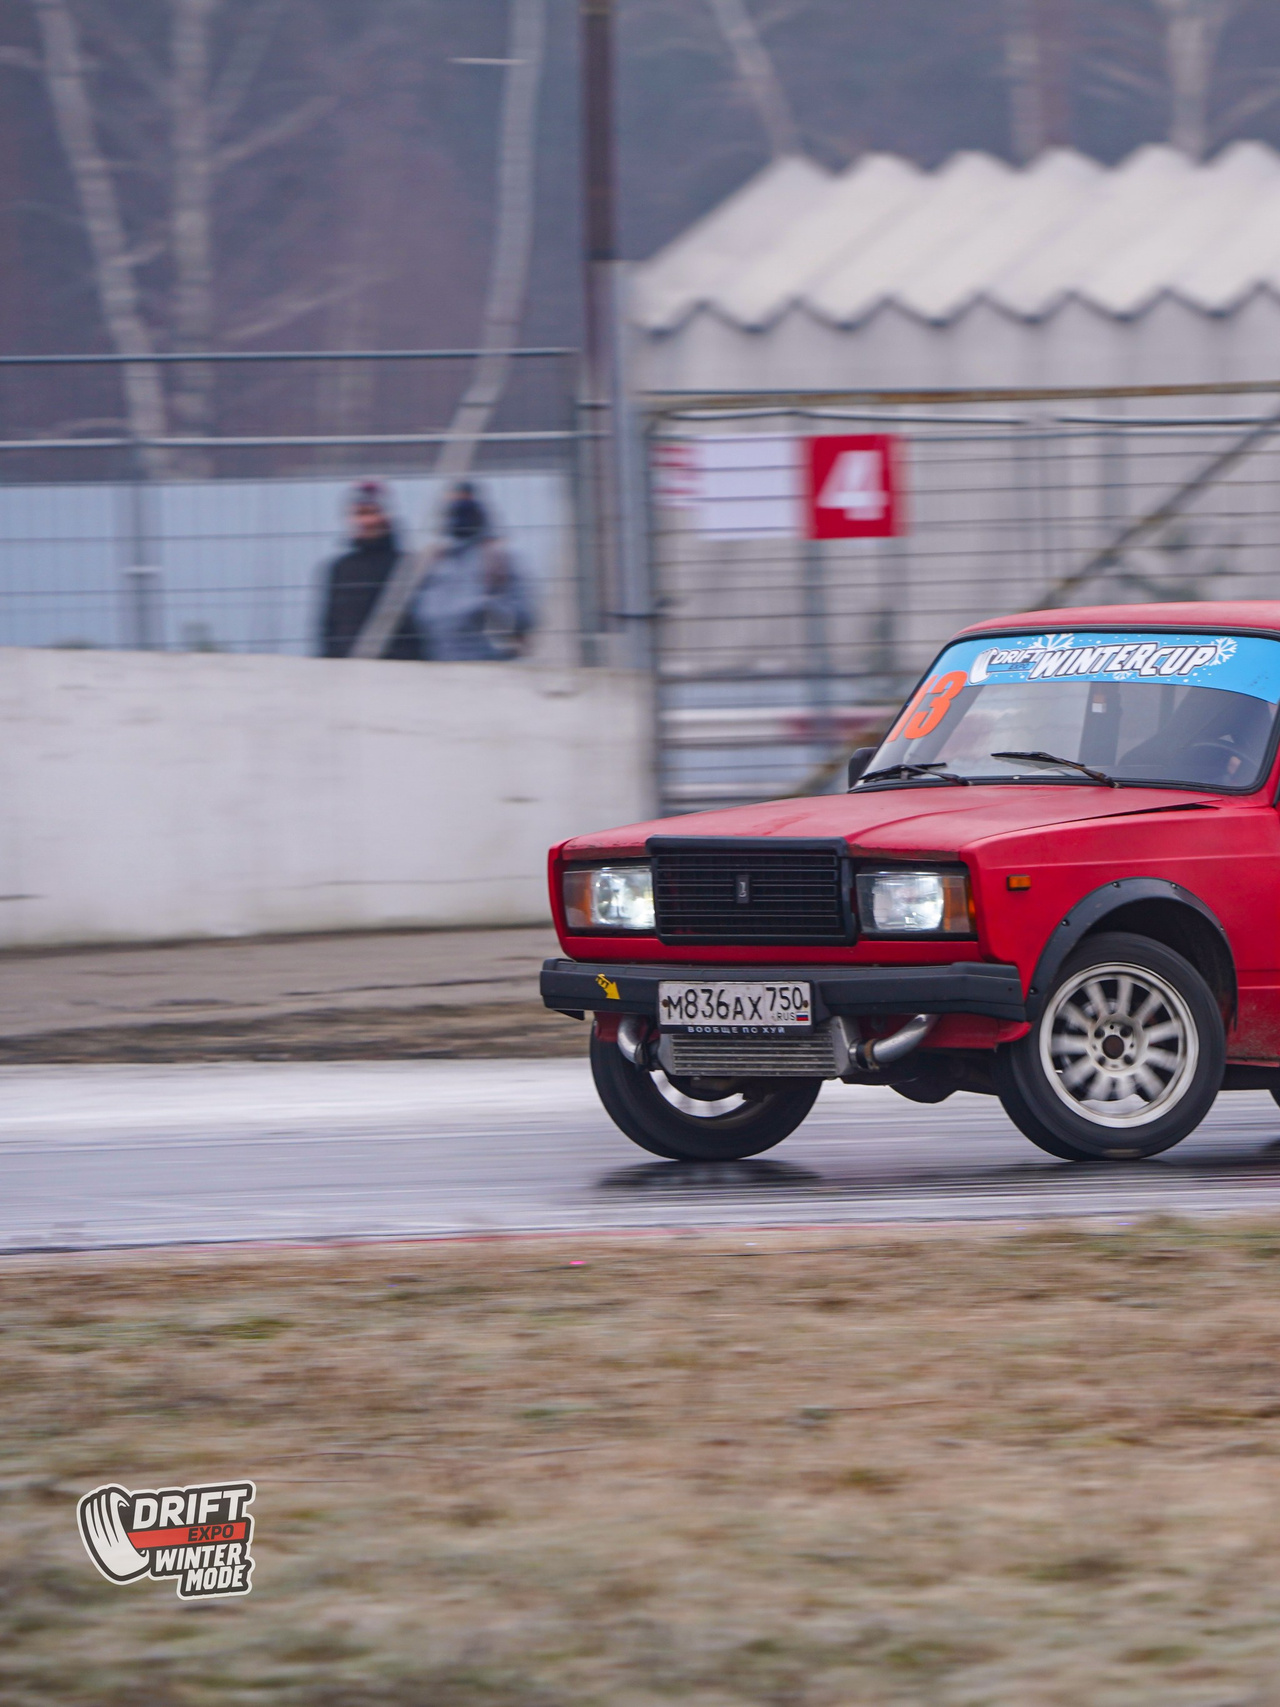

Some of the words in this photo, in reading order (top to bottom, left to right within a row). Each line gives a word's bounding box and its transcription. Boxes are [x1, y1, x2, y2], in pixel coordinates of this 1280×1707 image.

[815, 450, 890, 520] 4
[993, 650, 1040, 664] DRIFT
[776, 1013, 796, 1022] RUS
